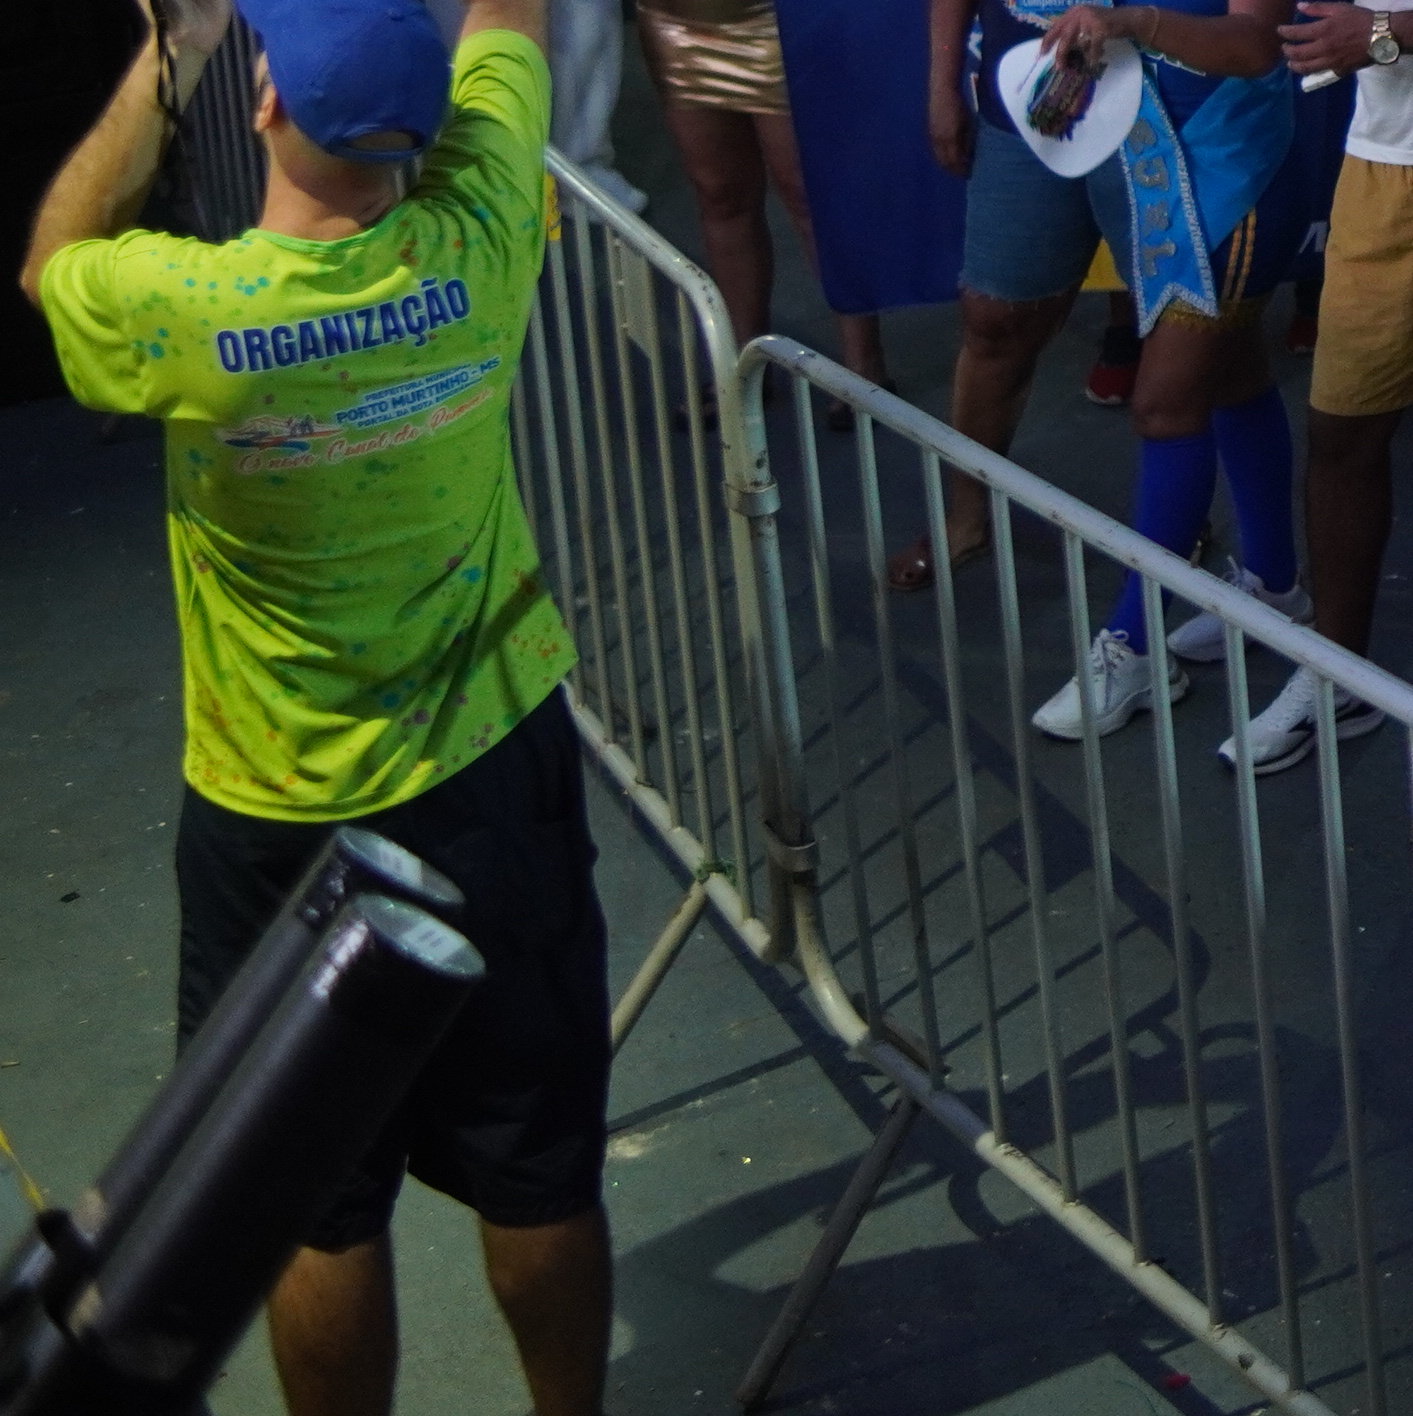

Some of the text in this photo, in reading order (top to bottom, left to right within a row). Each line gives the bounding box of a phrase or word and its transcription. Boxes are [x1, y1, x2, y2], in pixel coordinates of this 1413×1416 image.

[216, 277, 472, 374] ORGANIZAÇÃO
[335, 400, 389, 425] PORTO
[391, 370, 470, 409] MURTINHO
